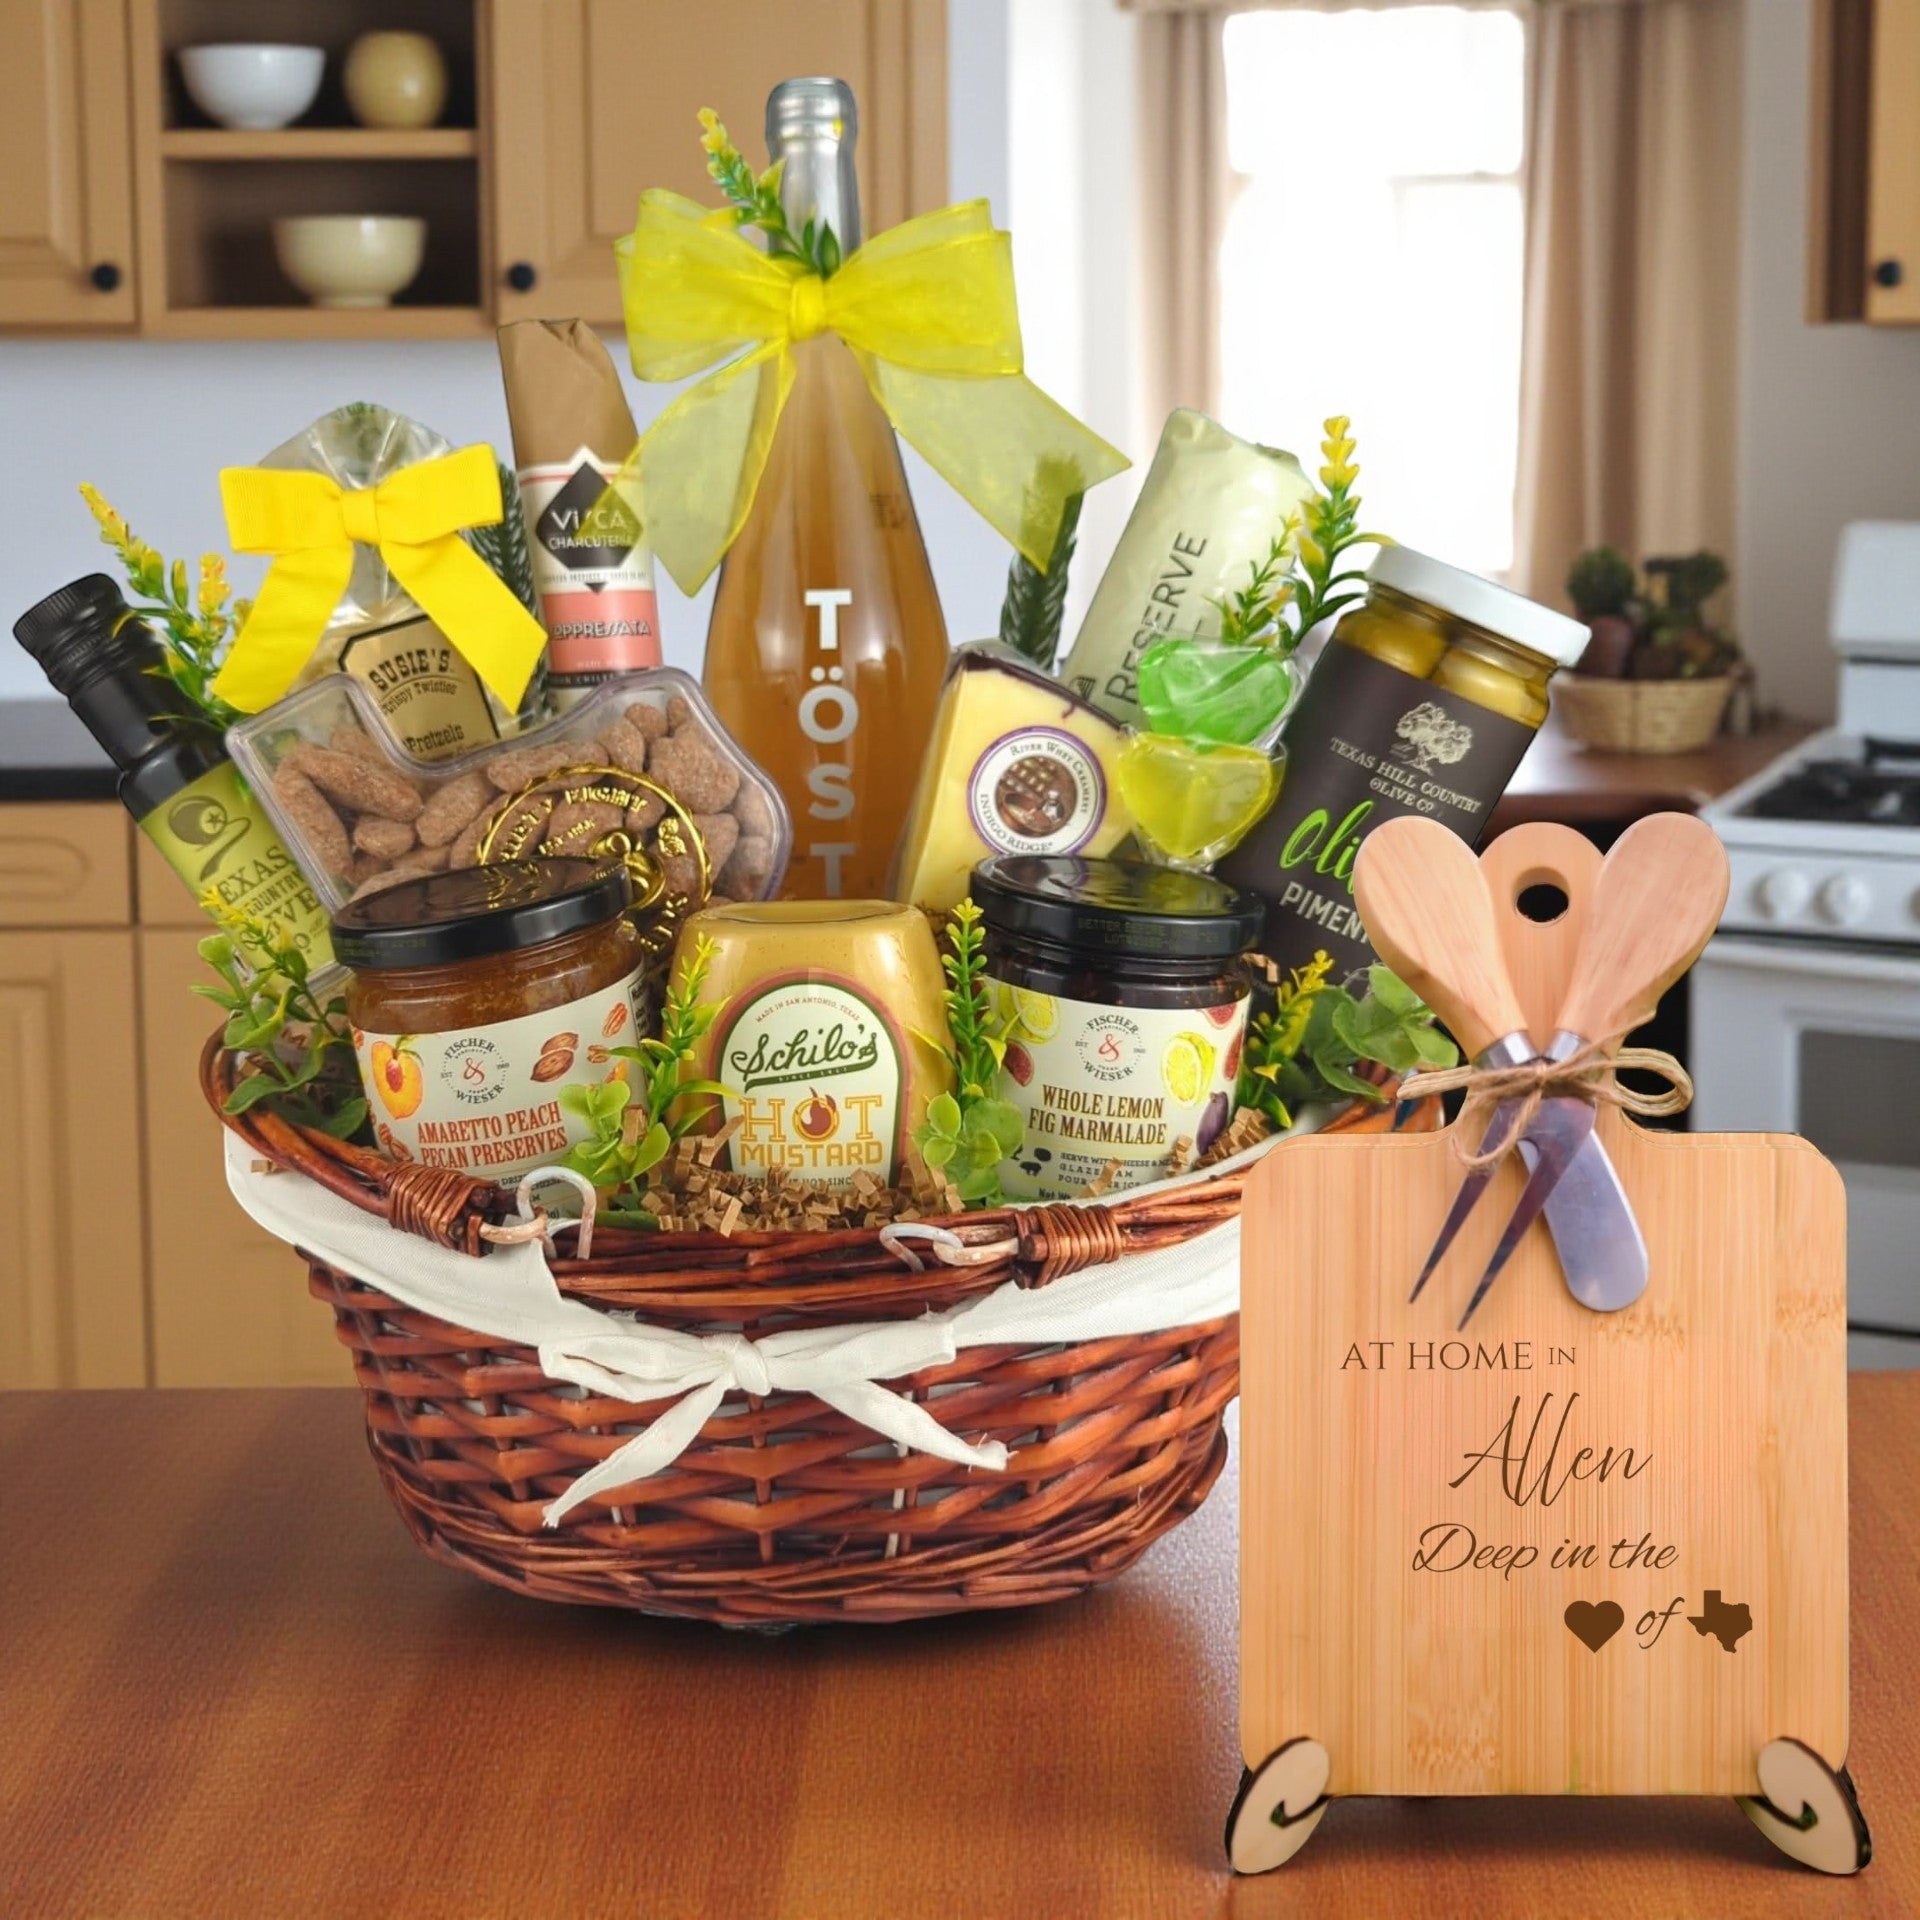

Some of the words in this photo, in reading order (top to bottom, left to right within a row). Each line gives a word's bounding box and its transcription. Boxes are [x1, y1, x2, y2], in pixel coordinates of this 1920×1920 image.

[368, 648, 451, 692] SUSIE'S
[403, 723, 465, 753] Pretzels
[1329, 736, 1376, 769] TEXAS
[1376, 761, 1417, 789] HILL
[1420, 780, 1482, 814] COUNTRY
[1368, 776, 1417, 807] OLIVE
[980, 793, 1008, 840] INDIGO
[217, 845, 290, 906] EXAS
[755, 1006, 775, 1023] MADE
[775, 1002, 785, 1010] IN
[785, 997, 800, 1007] SAN
[839, 1004, 861, 1021] TEXAS
[1086, 1014, 1139, 1035] FISCHER
[444, 1037, 495, 1059] FISCHER
[730, 1022, 879, 1083] Schilo's
[1098, 1033, 1123, 1063] &
[463, 1056, 486, 1086] &
[1084, 1060, 1133, 1081] WIESER
[456, 1084, 504, 1104] WIESER
[1043, 1084, 1103, 1116] WHOLE
[1106, 1095, 1164, 1119] LEMON
[417, 1115, 501, 1144] AMARETTO
[505, 1100, 563, 1135] PEACH
[739, 1091, 883, 1143] HOT
[1028, 1107, 1056, 1134] FIG
[1060, 1115, 1167, 1146] MARMALADE
[420, 1145, 470, 1169] PECAN
[471, 1126, 569, 1168] PRESERVES
[739, 1140, 884, 1168] MUSTARD
[1060, 1152, 1089, 1164] SERVE
[828, 1175, 853, 1187] SINC
[1058, 1174, 1088, 1186] POUR
[1060, 1163, 1100, 1176] GLAZE
[1340, 1342, 1394, 1371] AT
[1408, 1341, 1533, 1371] HOME
[1549, 1347, 1577, 1365] IN
[1448, 1392, 1653, 1508] Allen
[1411, 1523, 1540, 1582] Deep
[1550, 1537, 1600, 1570] in
[1608, 1532, 1679, 1570] the
[1635, 1596, 1685, 1650] of
